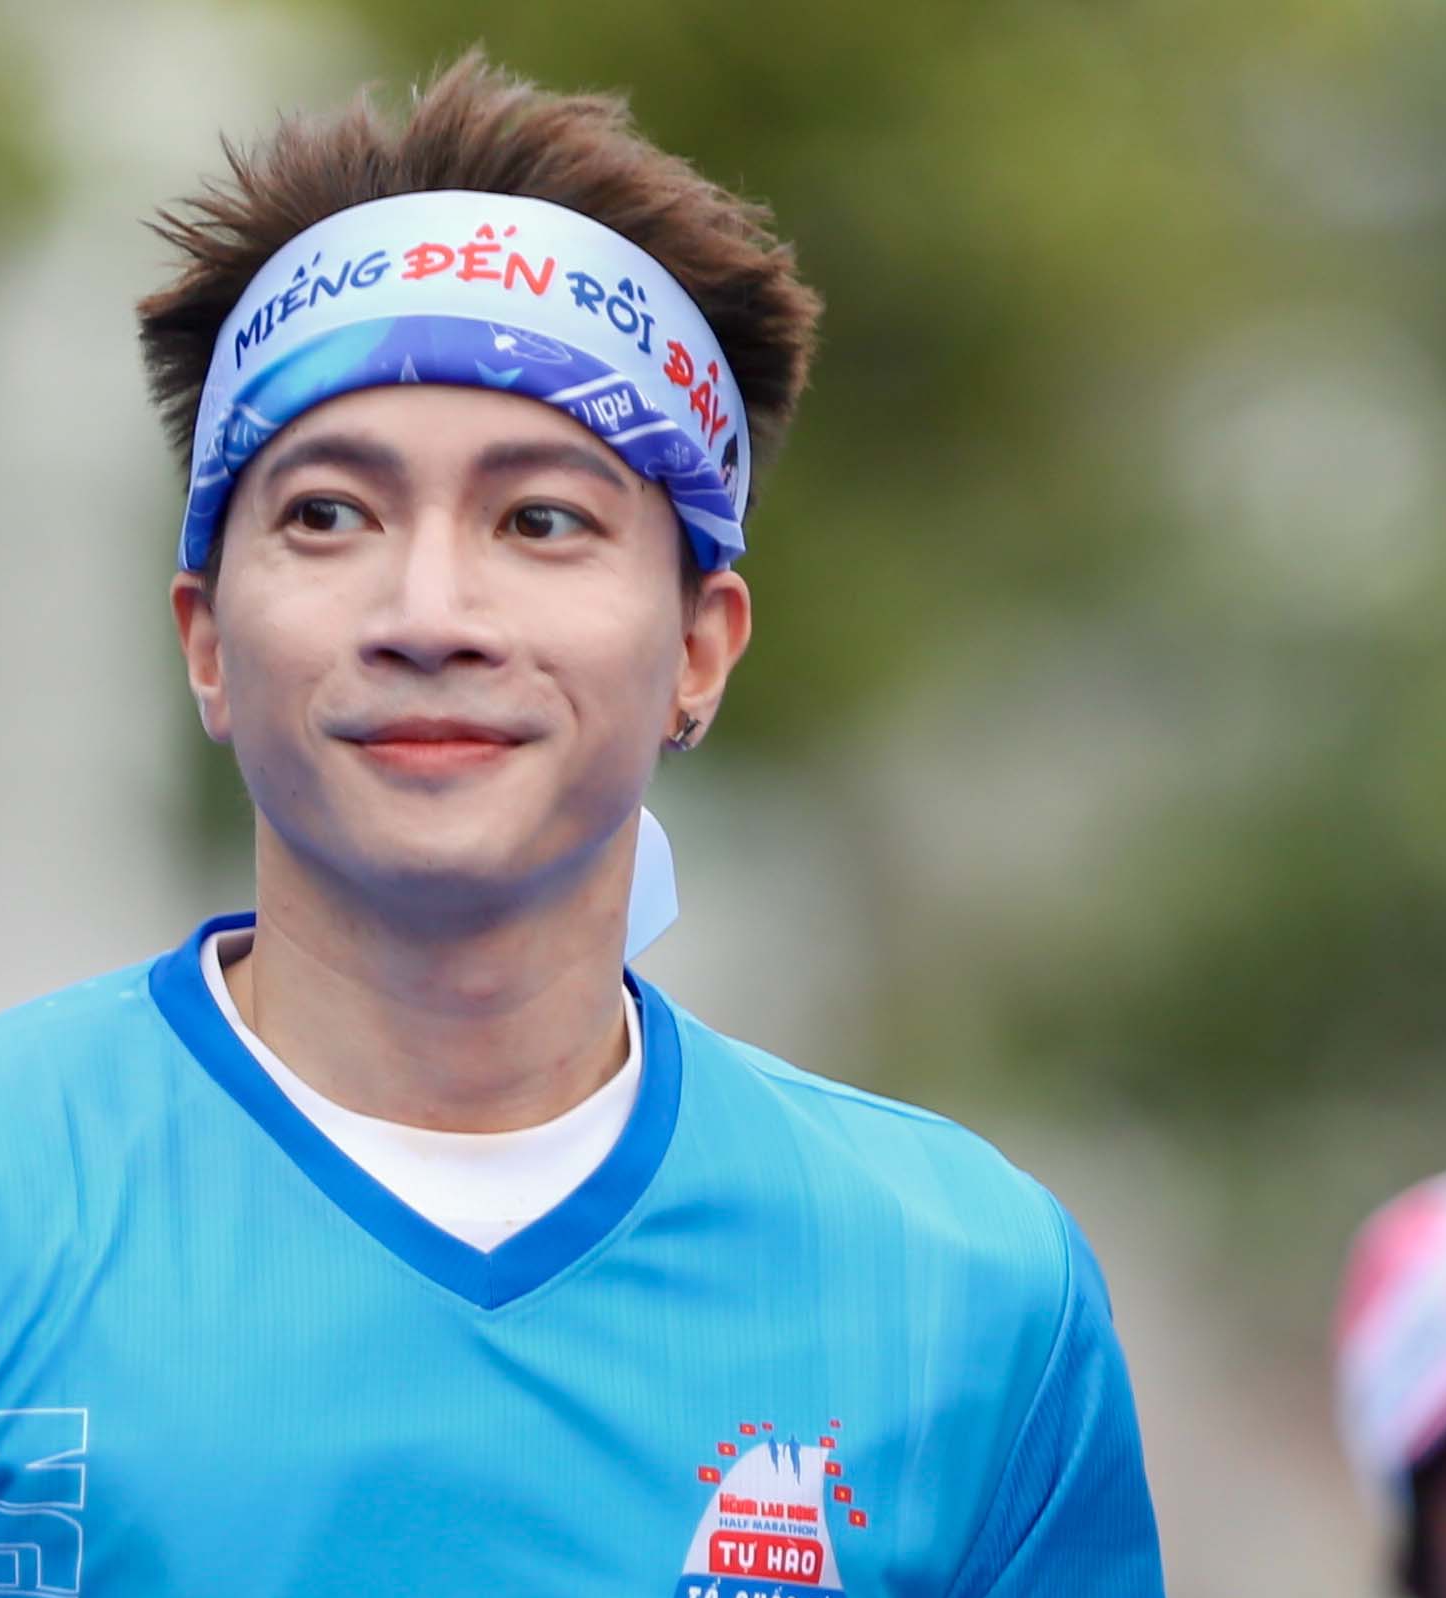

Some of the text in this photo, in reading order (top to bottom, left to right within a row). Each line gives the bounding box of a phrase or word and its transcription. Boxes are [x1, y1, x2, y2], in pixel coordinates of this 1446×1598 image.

[235, 250, 392, 370] MIẾNG
[400, 223, 556, 297] ĐẾN
[564, 270, 657, 354] RỒI
[719, 1517, 819, 1537] HALF MARATHON
[717, 1538, 816, 1576] TỰ HÀO
